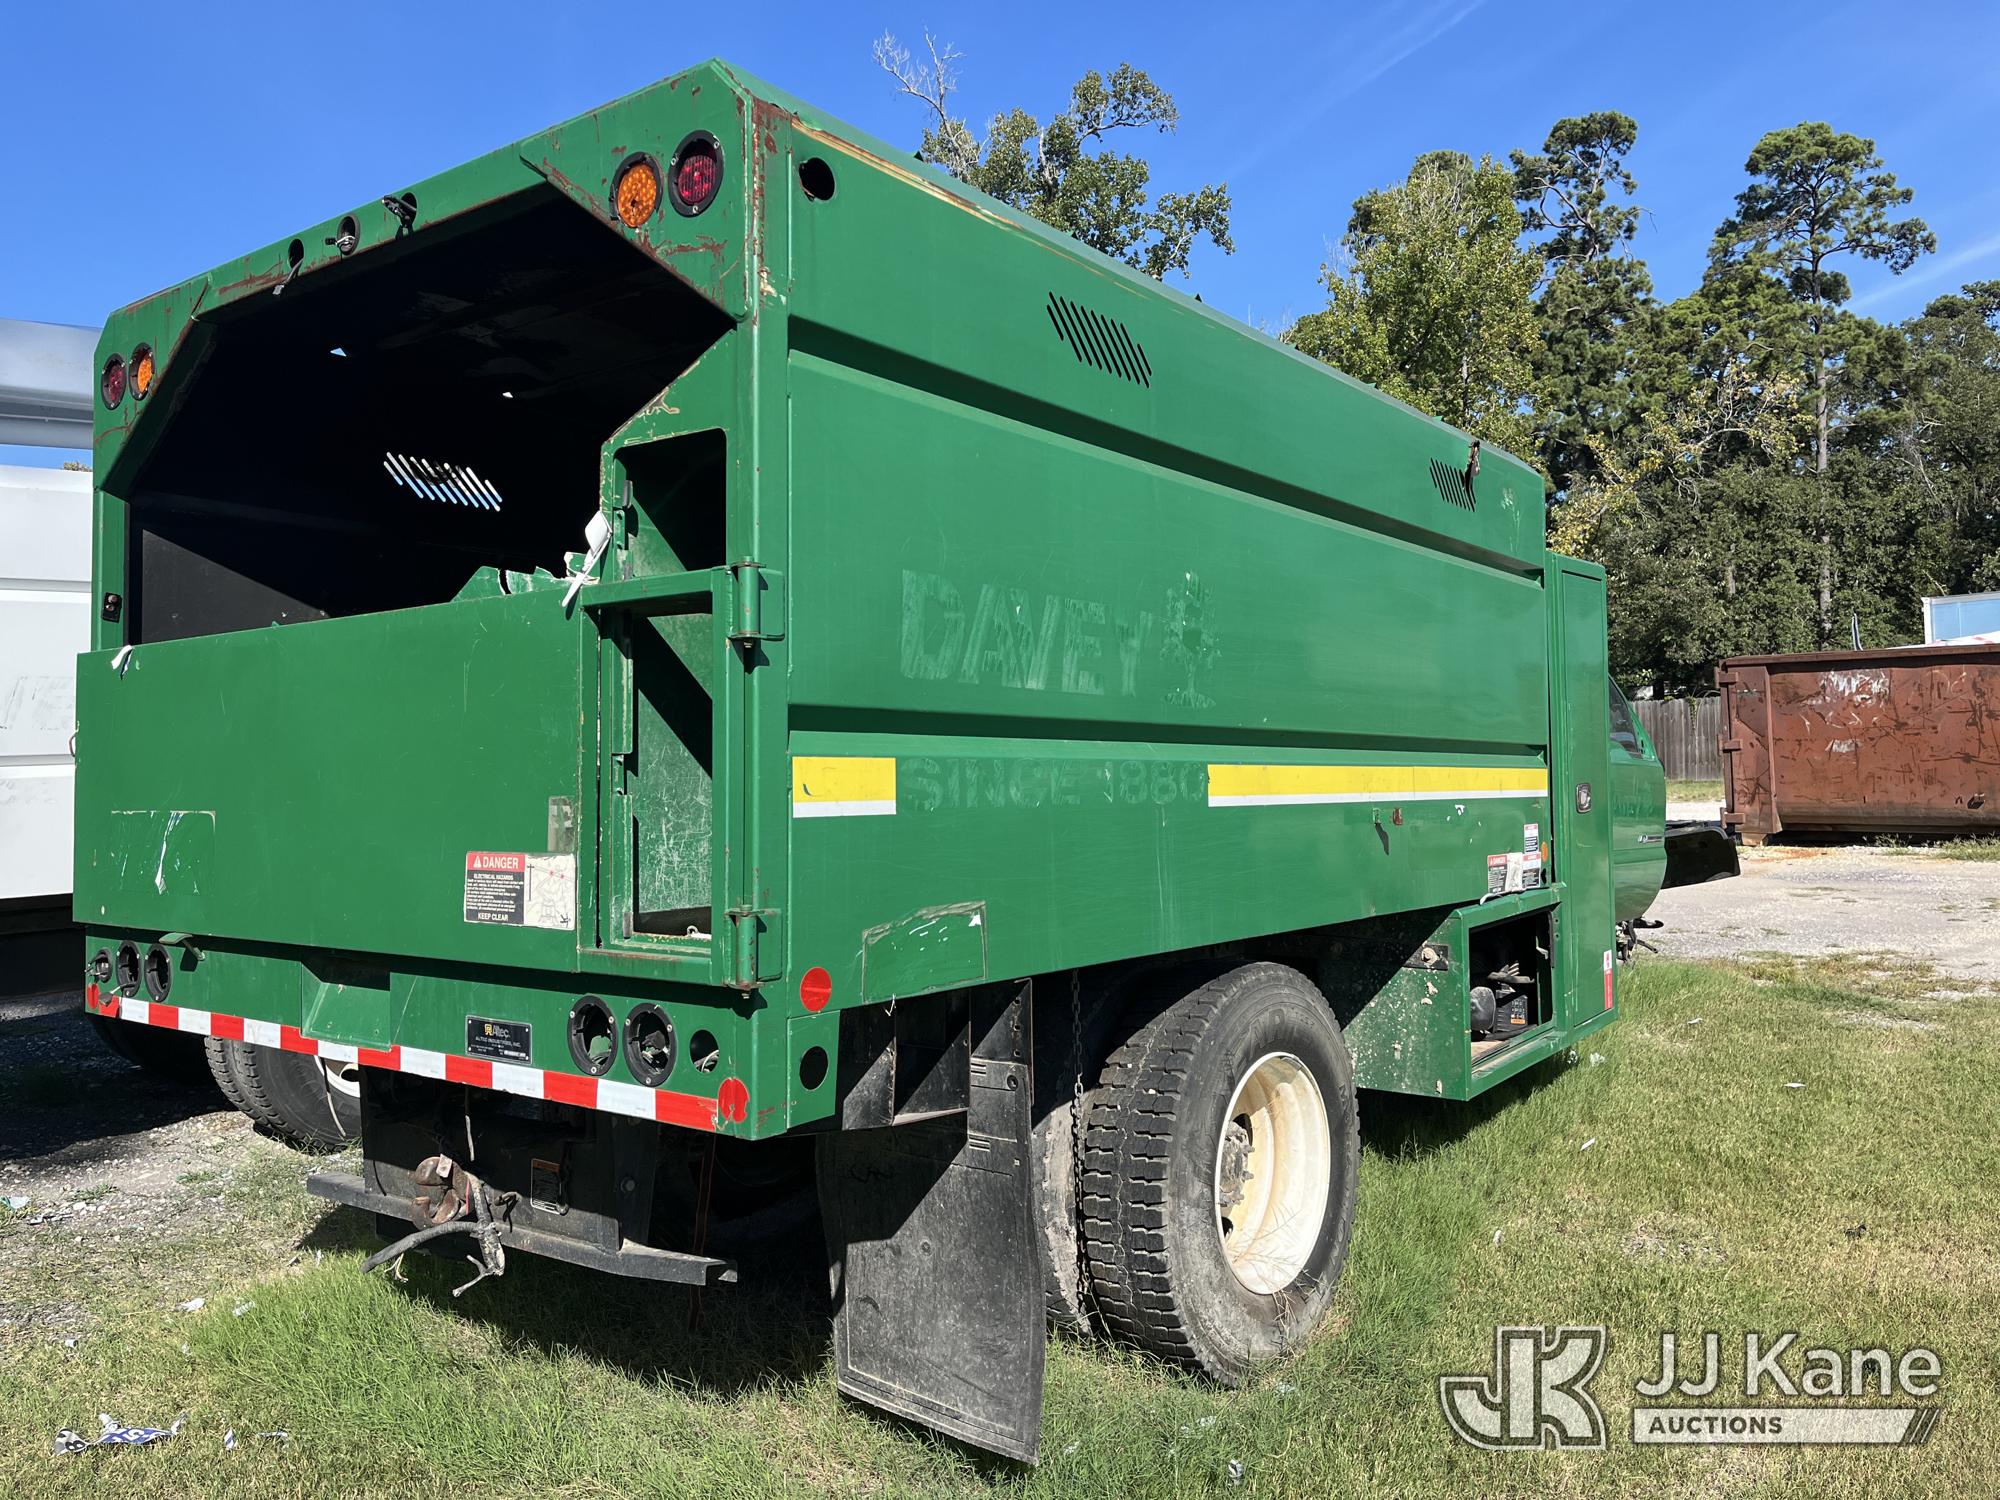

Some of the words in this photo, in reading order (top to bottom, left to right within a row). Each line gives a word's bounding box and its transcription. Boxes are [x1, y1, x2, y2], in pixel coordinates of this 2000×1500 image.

[482, 856, 519, 869] DANGER
[477, 912, 491, 920] KEEP
[491, 913, 509, 921] CLEAR
